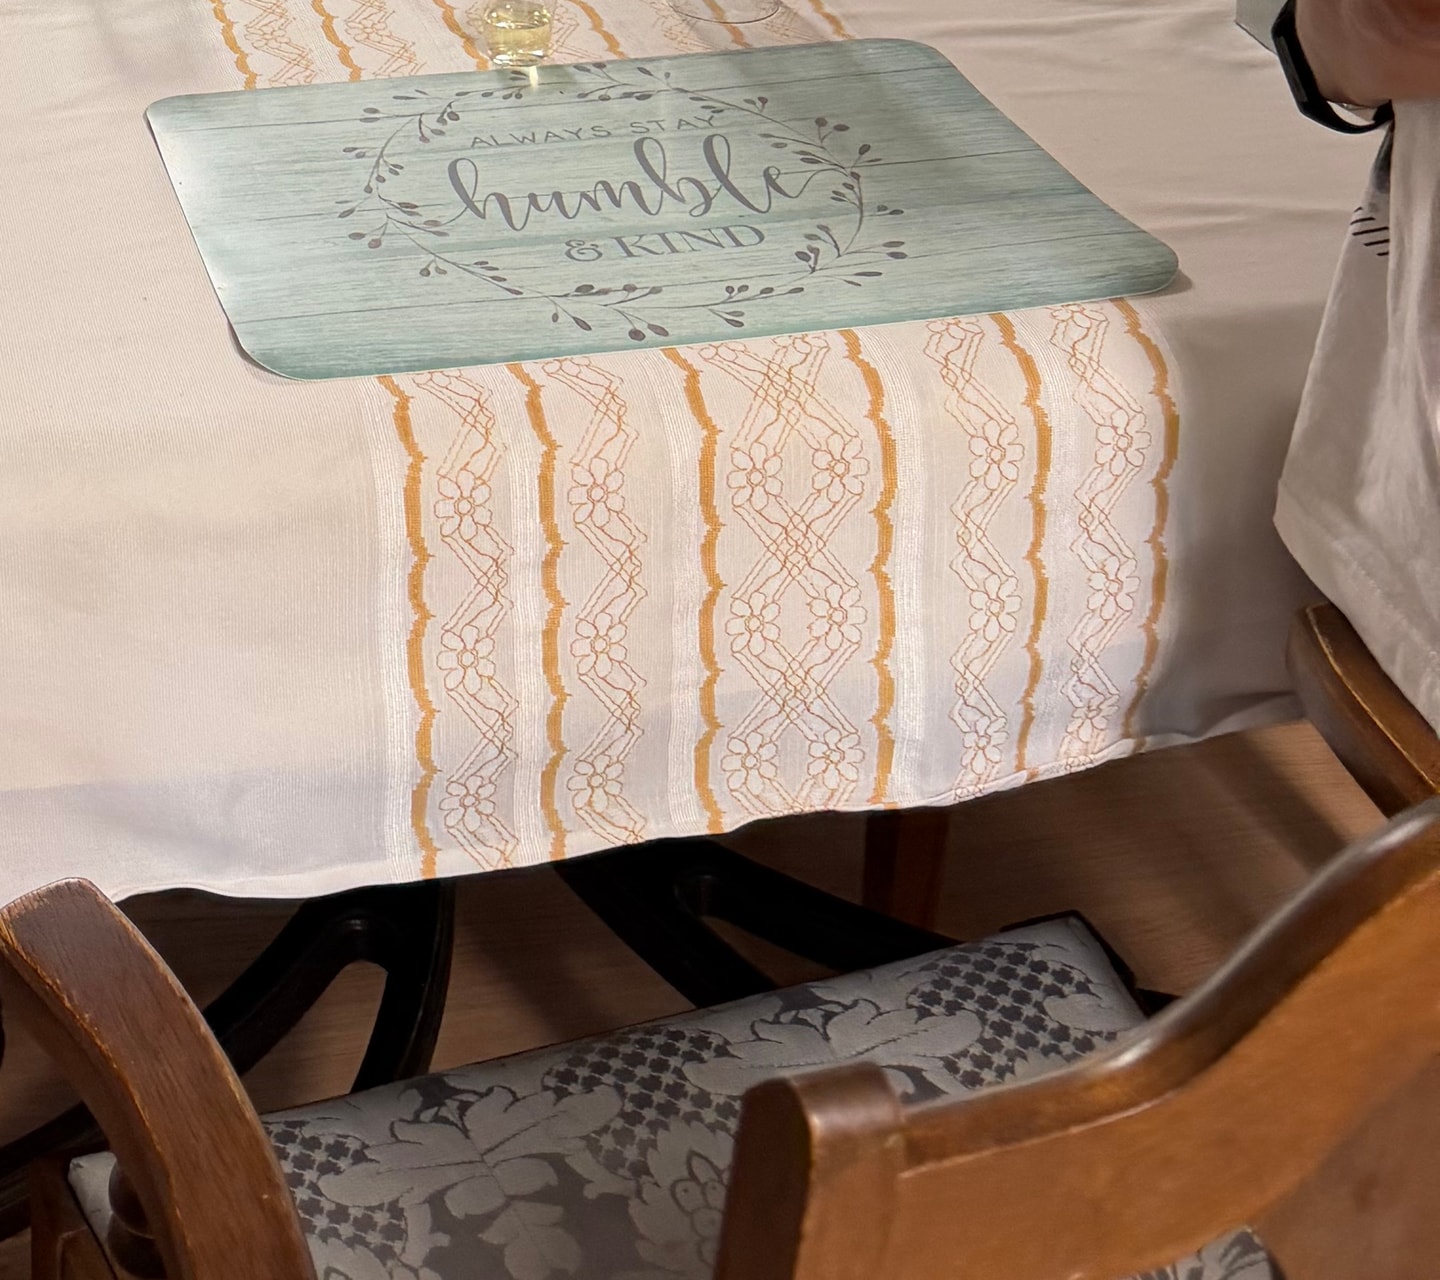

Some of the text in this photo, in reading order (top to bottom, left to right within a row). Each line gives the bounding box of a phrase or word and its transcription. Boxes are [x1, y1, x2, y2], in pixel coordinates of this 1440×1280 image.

[470, 114, 716, 149] ALWAYS STAY
[444, 133, 810, 232] humble
[564, 223, 766, 263] & KIND
